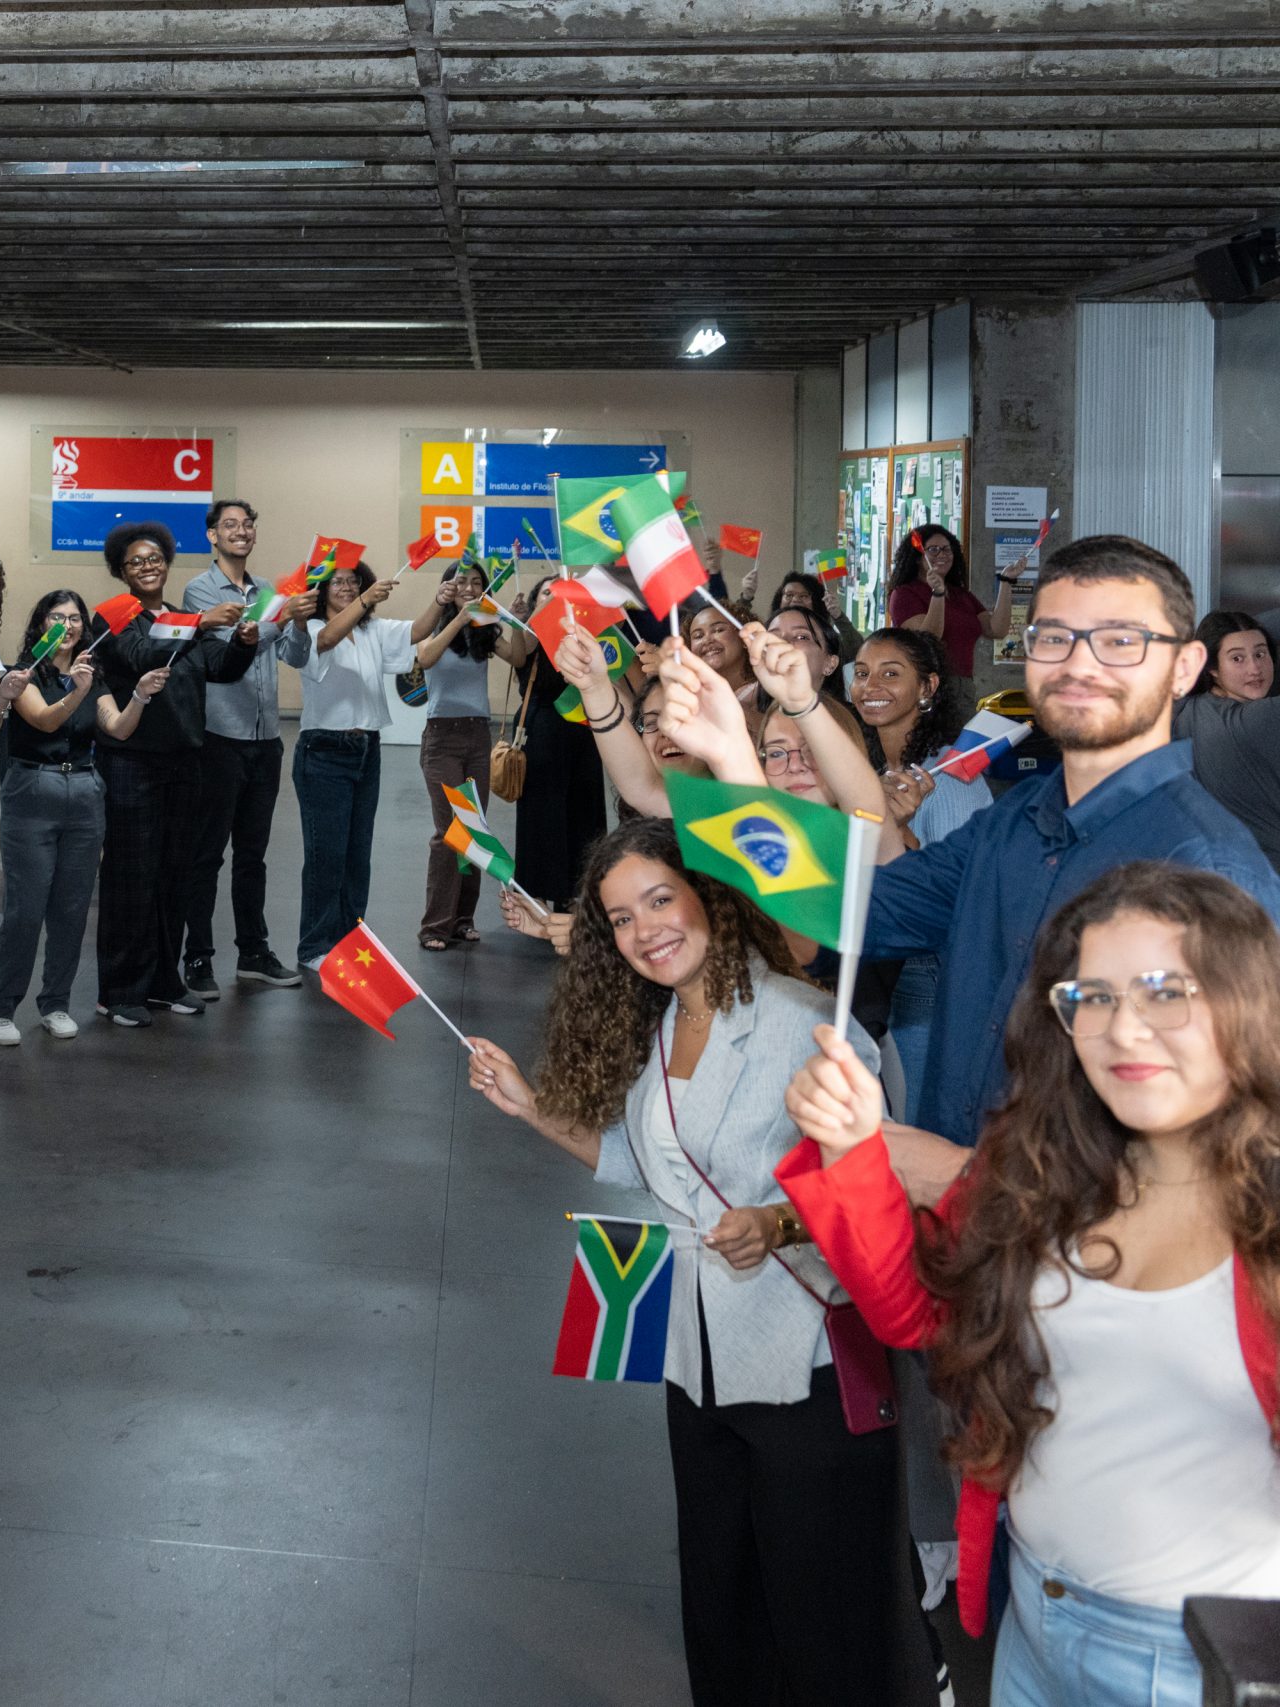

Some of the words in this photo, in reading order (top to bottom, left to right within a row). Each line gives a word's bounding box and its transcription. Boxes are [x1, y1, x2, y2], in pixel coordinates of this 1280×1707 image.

[173, 449, 201, 481] C
[432, 453, 463, 484] A
[69, 490, 95, 499] andar
[489, 482, 519, 490] Instituto
[521, 482, 532, 490] de
[434, 516, 460, 547] B
